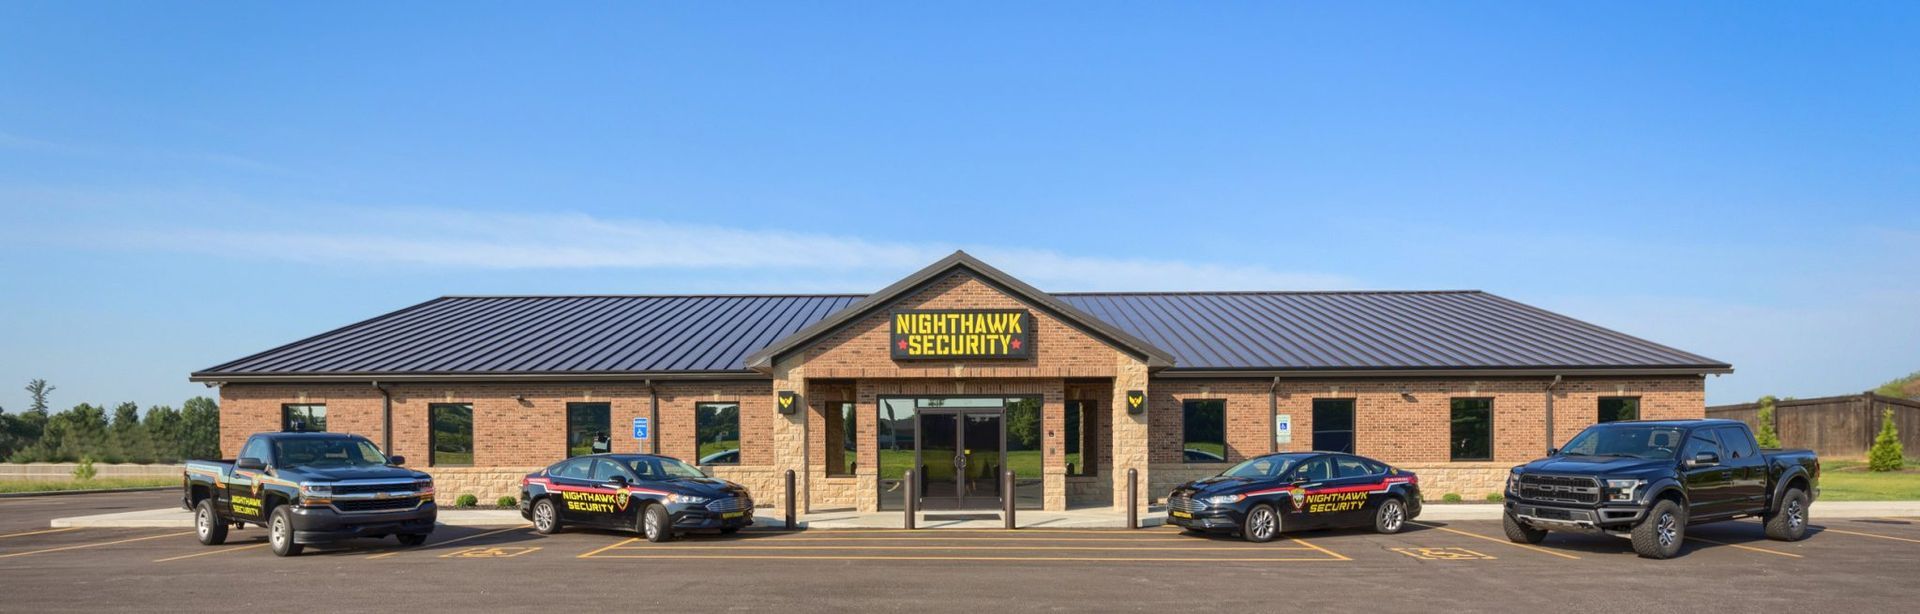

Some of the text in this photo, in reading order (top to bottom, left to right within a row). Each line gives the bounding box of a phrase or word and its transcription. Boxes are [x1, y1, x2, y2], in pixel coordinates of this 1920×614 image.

[896, 313, 1022, 334] NIGHTHAWK
[908, 334, 1011, 355] SECURITY
[1521, 482, 1599, 494] FORD
[562, 490, 616, 504] NIGHTHAWK
[1306, 491, 1368, 503] NIGHTHAWK
[232, 504, 259, 517] SECURITY
[567, 501, 614, 513] SECURITY
[1309, 501, 1365, 513] SECURITY
